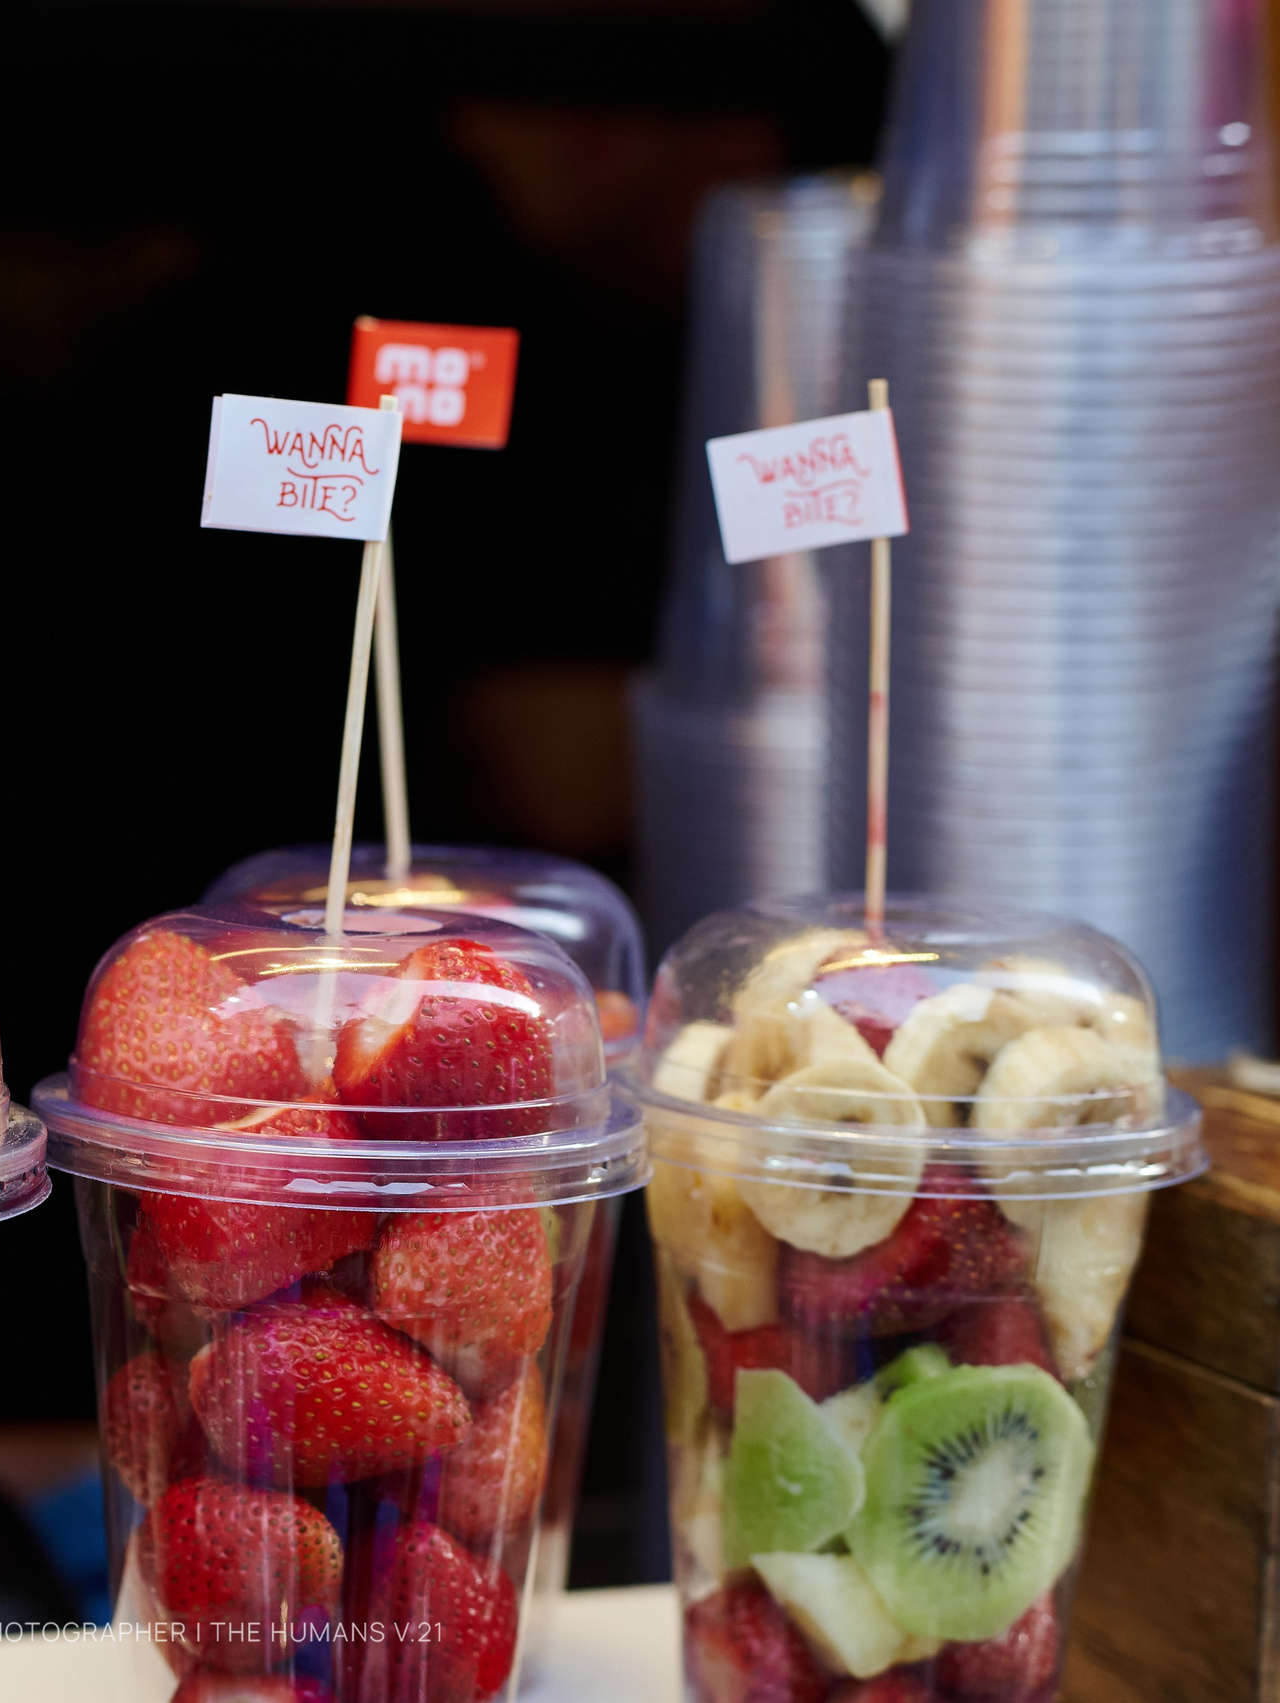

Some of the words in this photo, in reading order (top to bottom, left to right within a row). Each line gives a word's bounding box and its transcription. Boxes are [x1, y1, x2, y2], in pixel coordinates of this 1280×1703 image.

[250, 418, 380, 475] WANNA
[736, 433, 872, 487] WANNA
[276, 467, 364, 522] BITE?
[783, 478, 863, 530] BITE?
